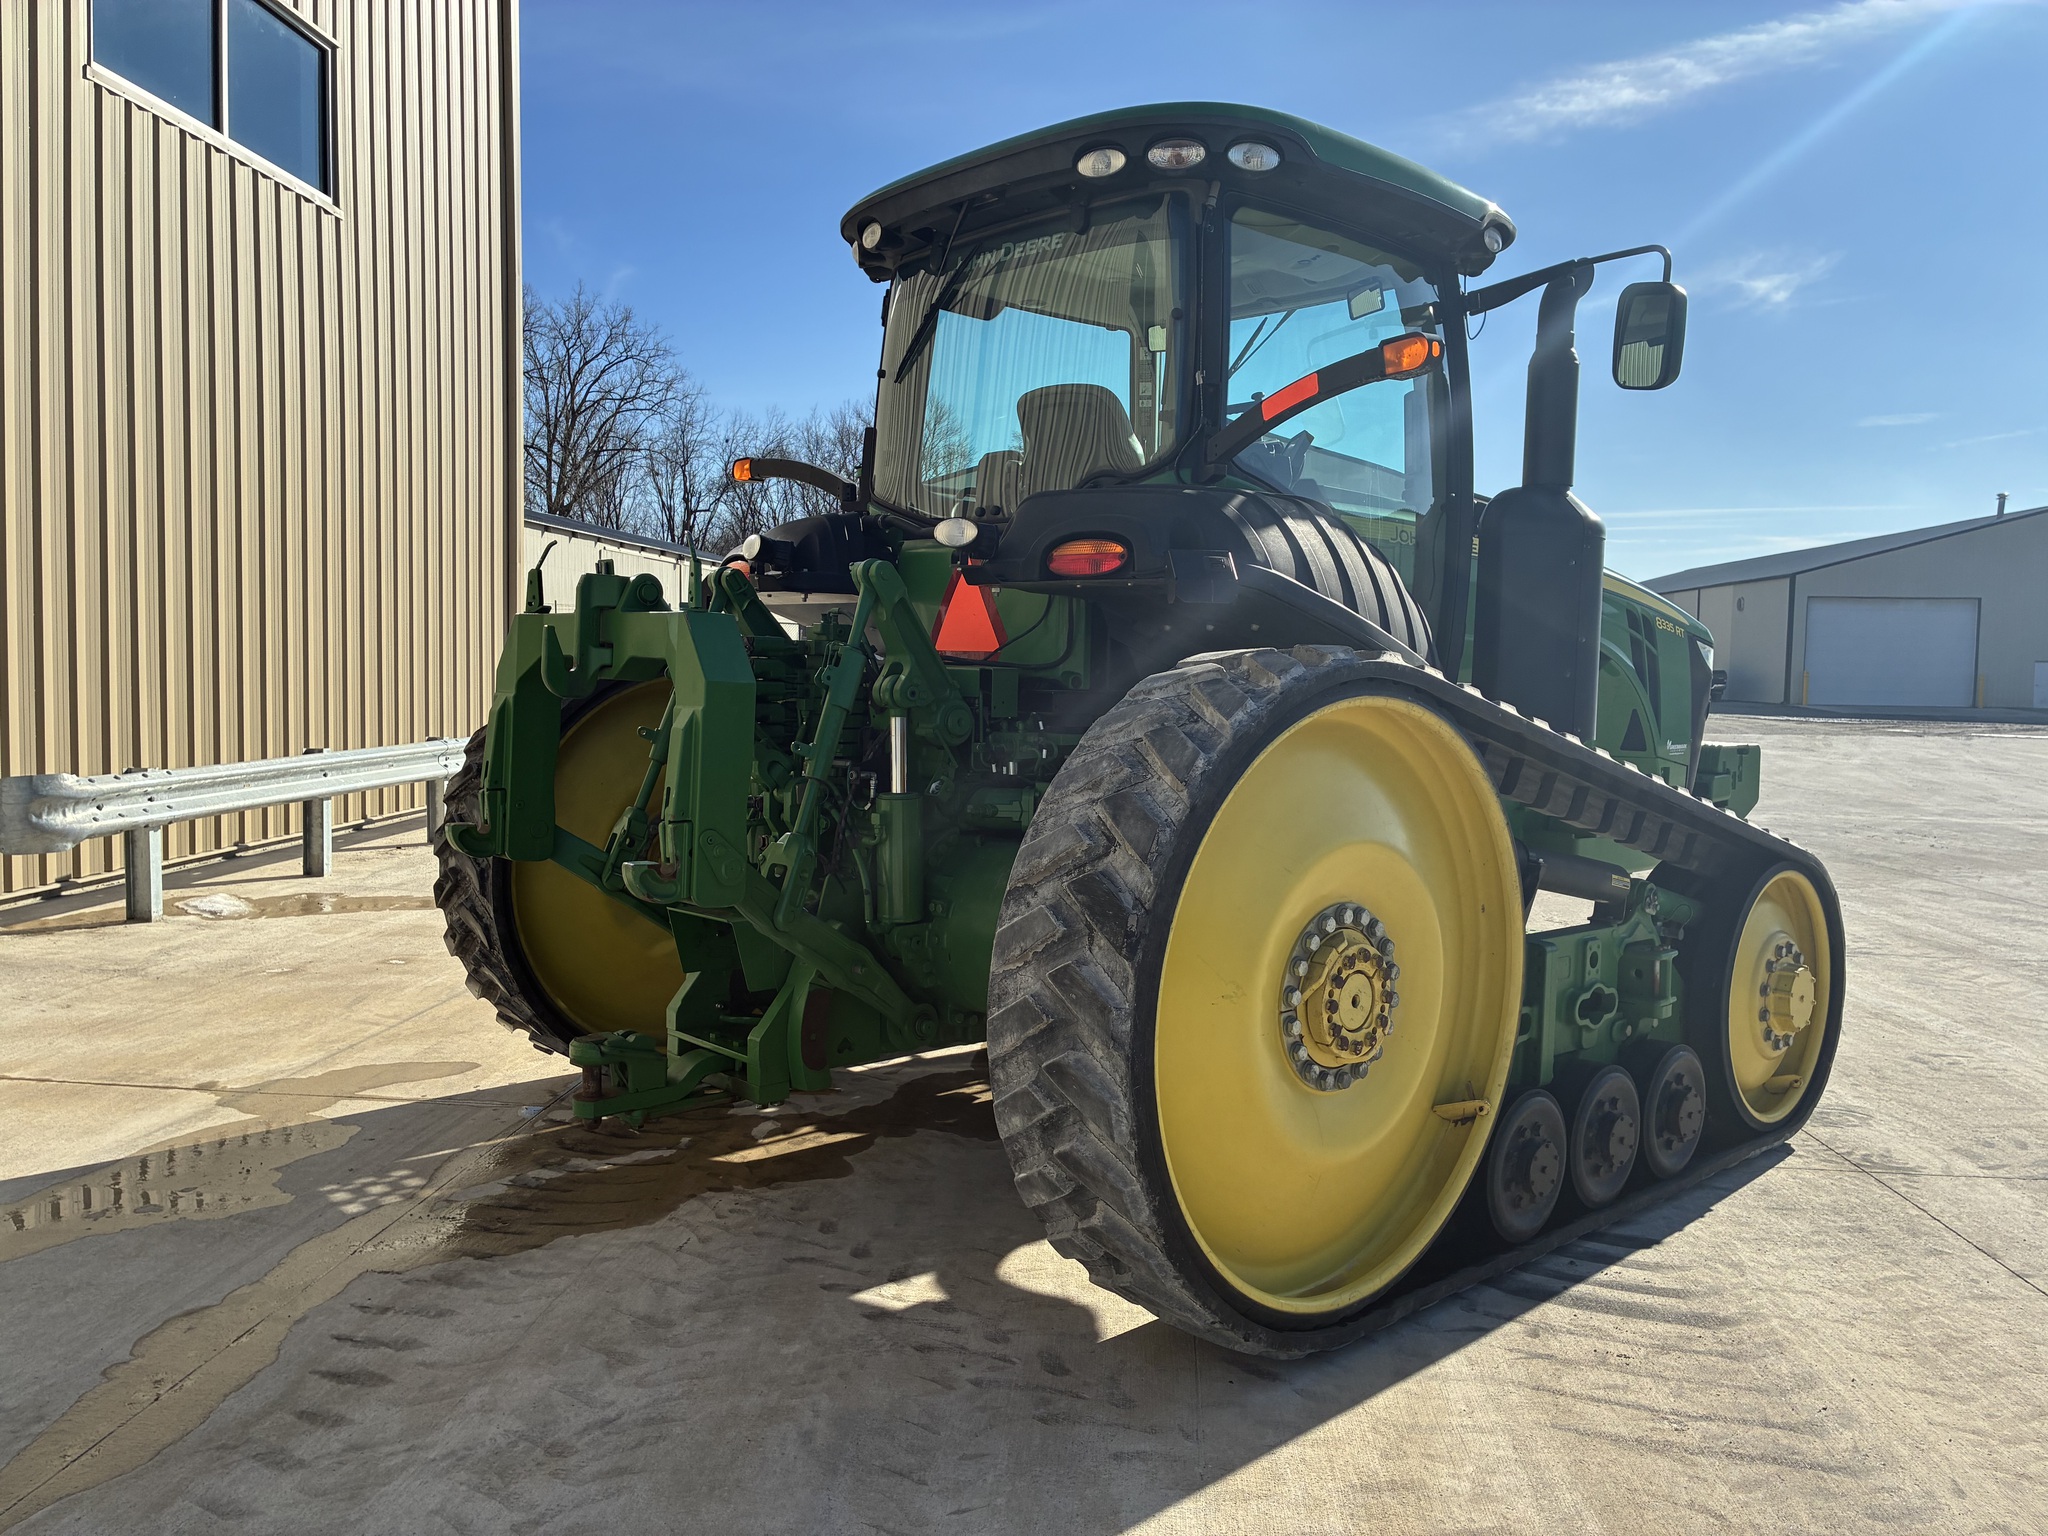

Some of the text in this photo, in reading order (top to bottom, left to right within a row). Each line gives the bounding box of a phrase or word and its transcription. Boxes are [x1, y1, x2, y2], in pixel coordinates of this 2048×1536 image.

[1000, 232, 1066, 262] DEERE
[1656, 617, 1685, 638] 8335 RT
